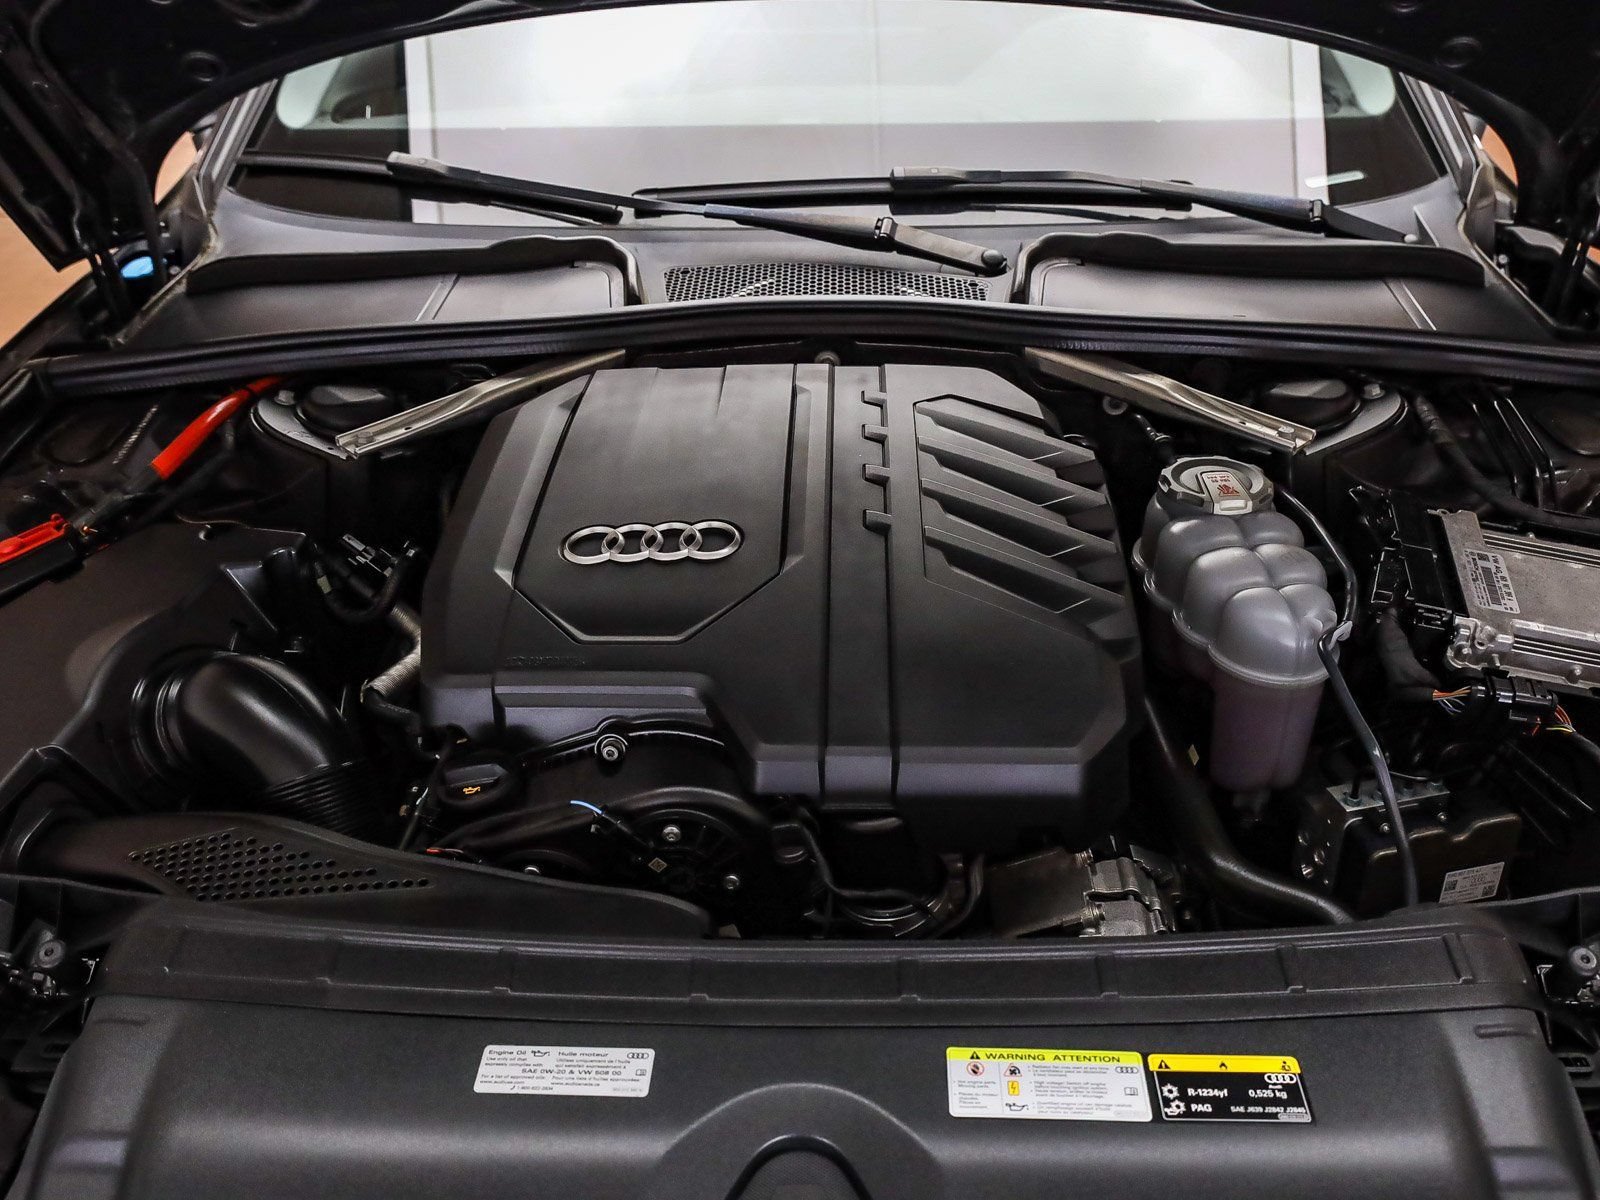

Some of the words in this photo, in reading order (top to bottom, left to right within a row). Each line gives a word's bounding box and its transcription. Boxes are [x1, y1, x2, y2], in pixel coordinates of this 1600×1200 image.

[985, 1052, 1046, 1062] WARNING
[1053, 1054, 1121, 1063] ATTENTION
[1187, 1088, 1228, 1098] R-1234yf
[1275, 1089, 1288, 1099] kg
[1190, 1104, 1212, 1112] PAG
